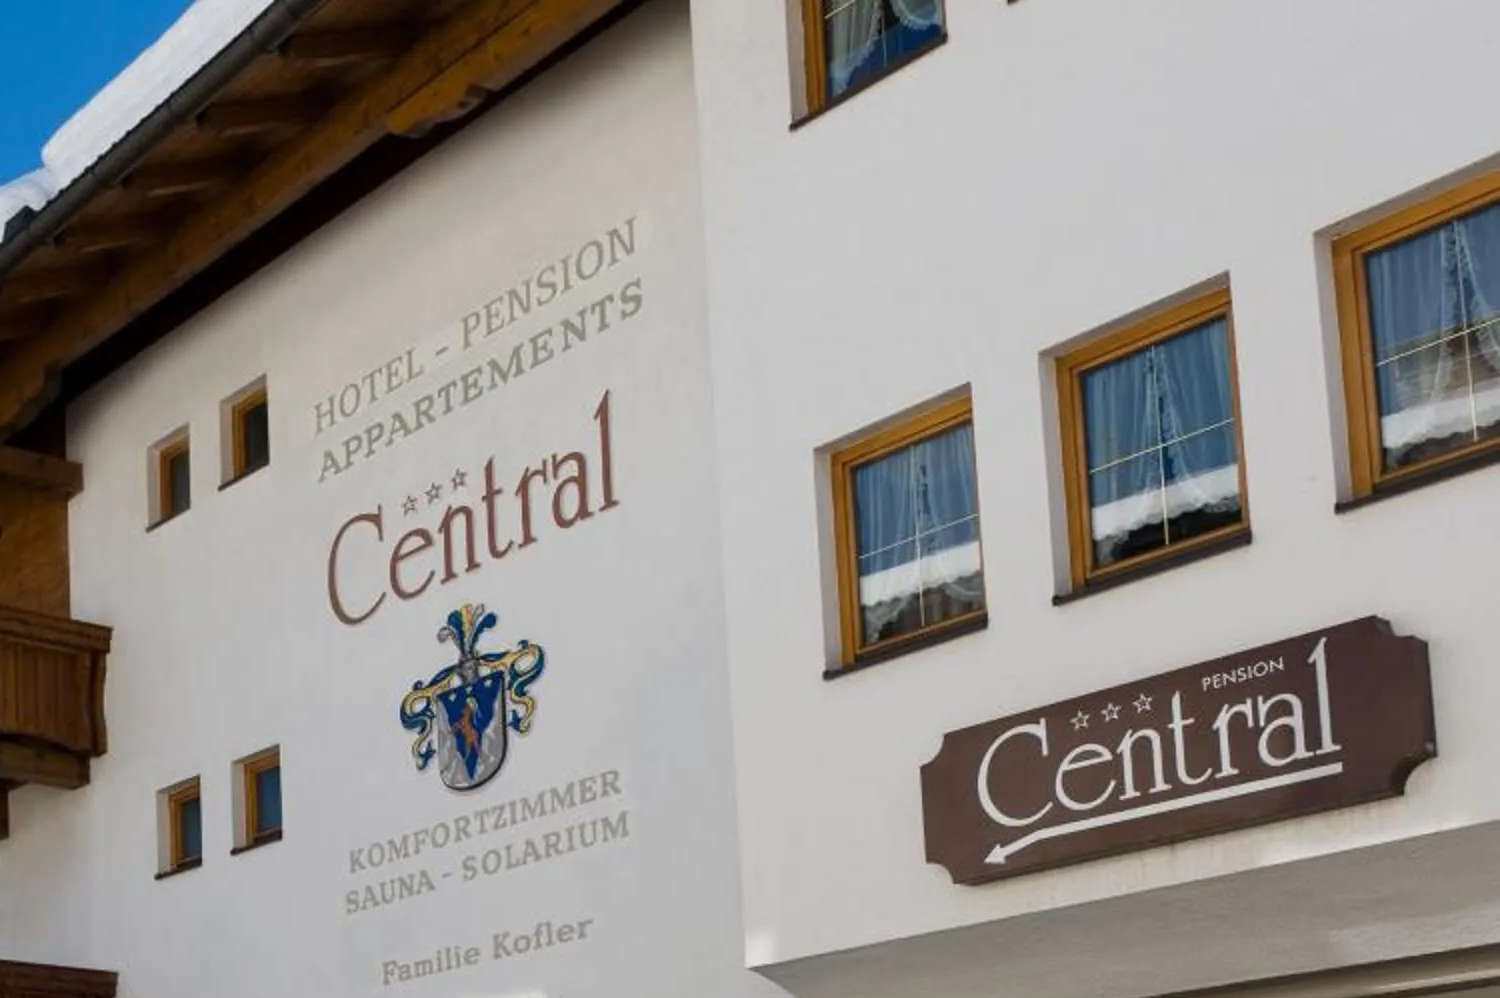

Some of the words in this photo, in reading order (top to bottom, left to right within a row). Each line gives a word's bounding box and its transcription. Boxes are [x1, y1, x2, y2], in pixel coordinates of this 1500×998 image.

[313, 346, 425, 434] HOTEL
[460, 216, 637, 351] PENSION
[318, 278, 643, 482] APPARTEMENTS
[327, 388, 620, 626] Central
[977, 636, 1342, 828] Central
[1202, 656, 1285, 691] PENSION
[345, 869, 436, 914] SAUNA
[462, 811, 631, 882] SOLARIUM
[348, 769, 622, 873] KOMFORTZIMMER
[381, 945, 481, 985] Familie
[492, 918, 594, 960] Kofler
